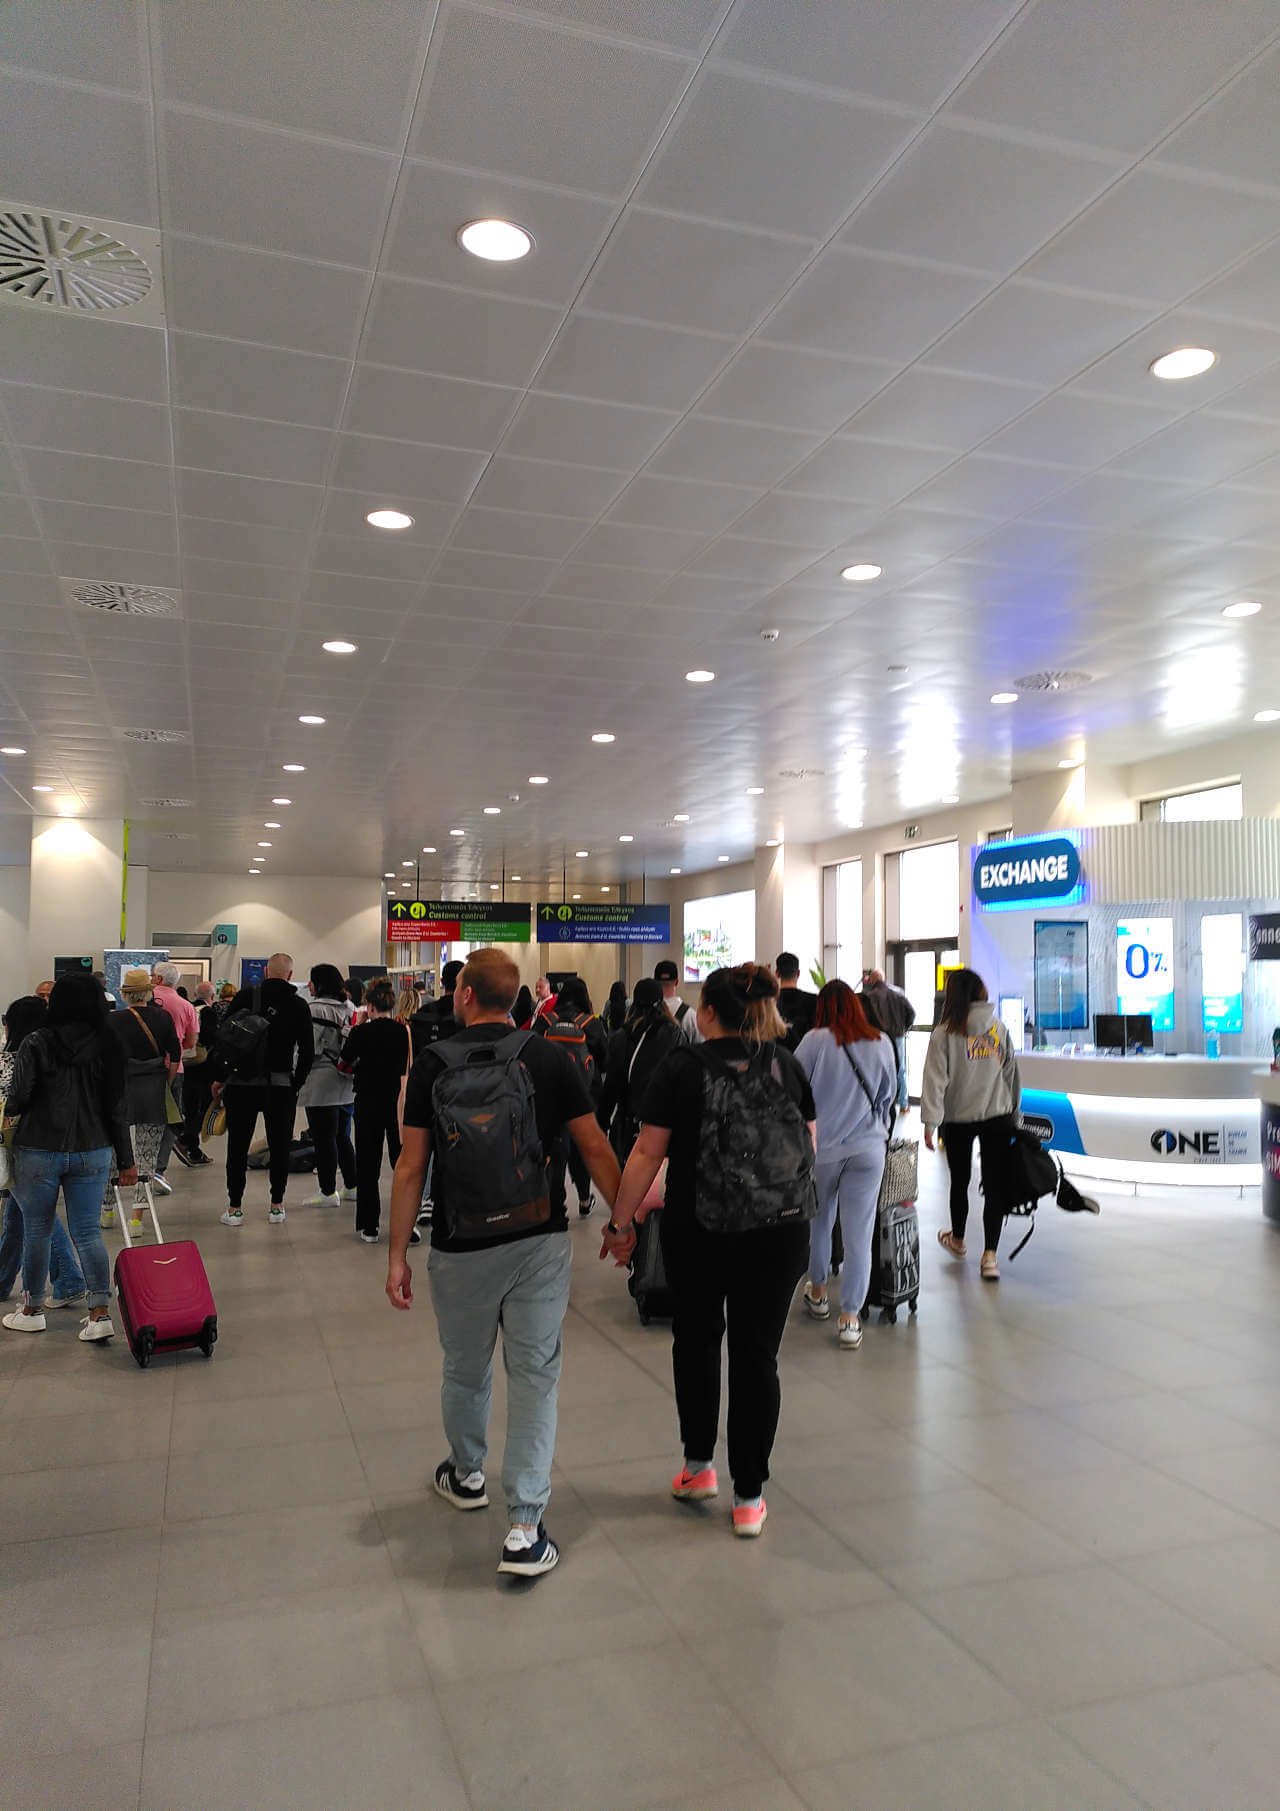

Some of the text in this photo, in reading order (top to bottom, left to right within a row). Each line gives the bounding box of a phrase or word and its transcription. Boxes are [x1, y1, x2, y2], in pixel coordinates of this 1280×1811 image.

[981, 855, 1068, 888] EXCHANGE
[428, 911, 487, 920] Customs control
[574, 913, 605, 921] Customs
